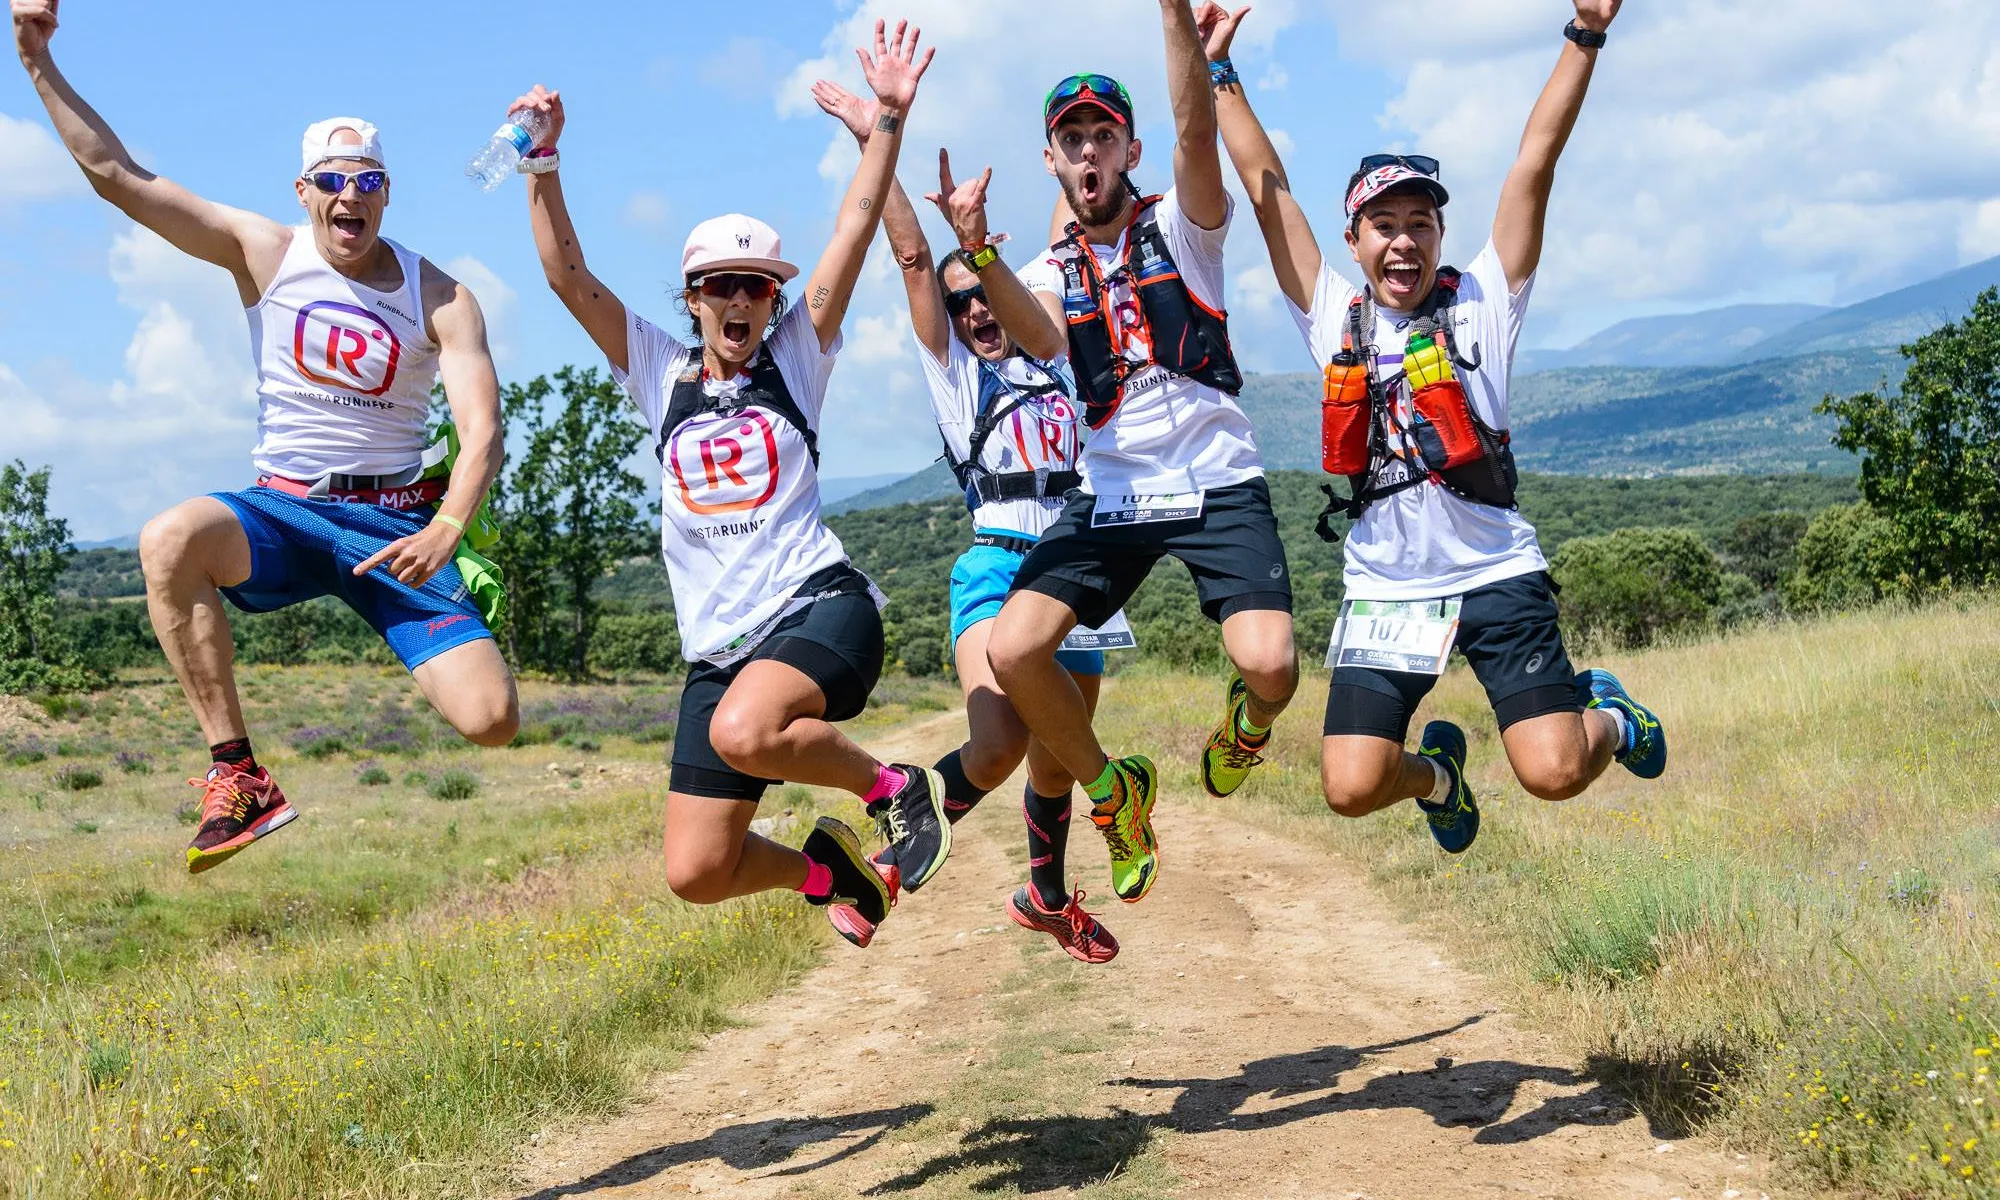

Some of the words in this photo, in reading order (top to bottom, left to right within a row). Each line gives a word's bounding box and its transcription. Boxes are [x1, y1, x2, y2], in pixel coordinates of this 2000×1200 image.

[376, 300, 417, 326] RUNBRANDS
[380, 488, 424, 509] MAX
[1409, 658, 1431, 667] DKV
